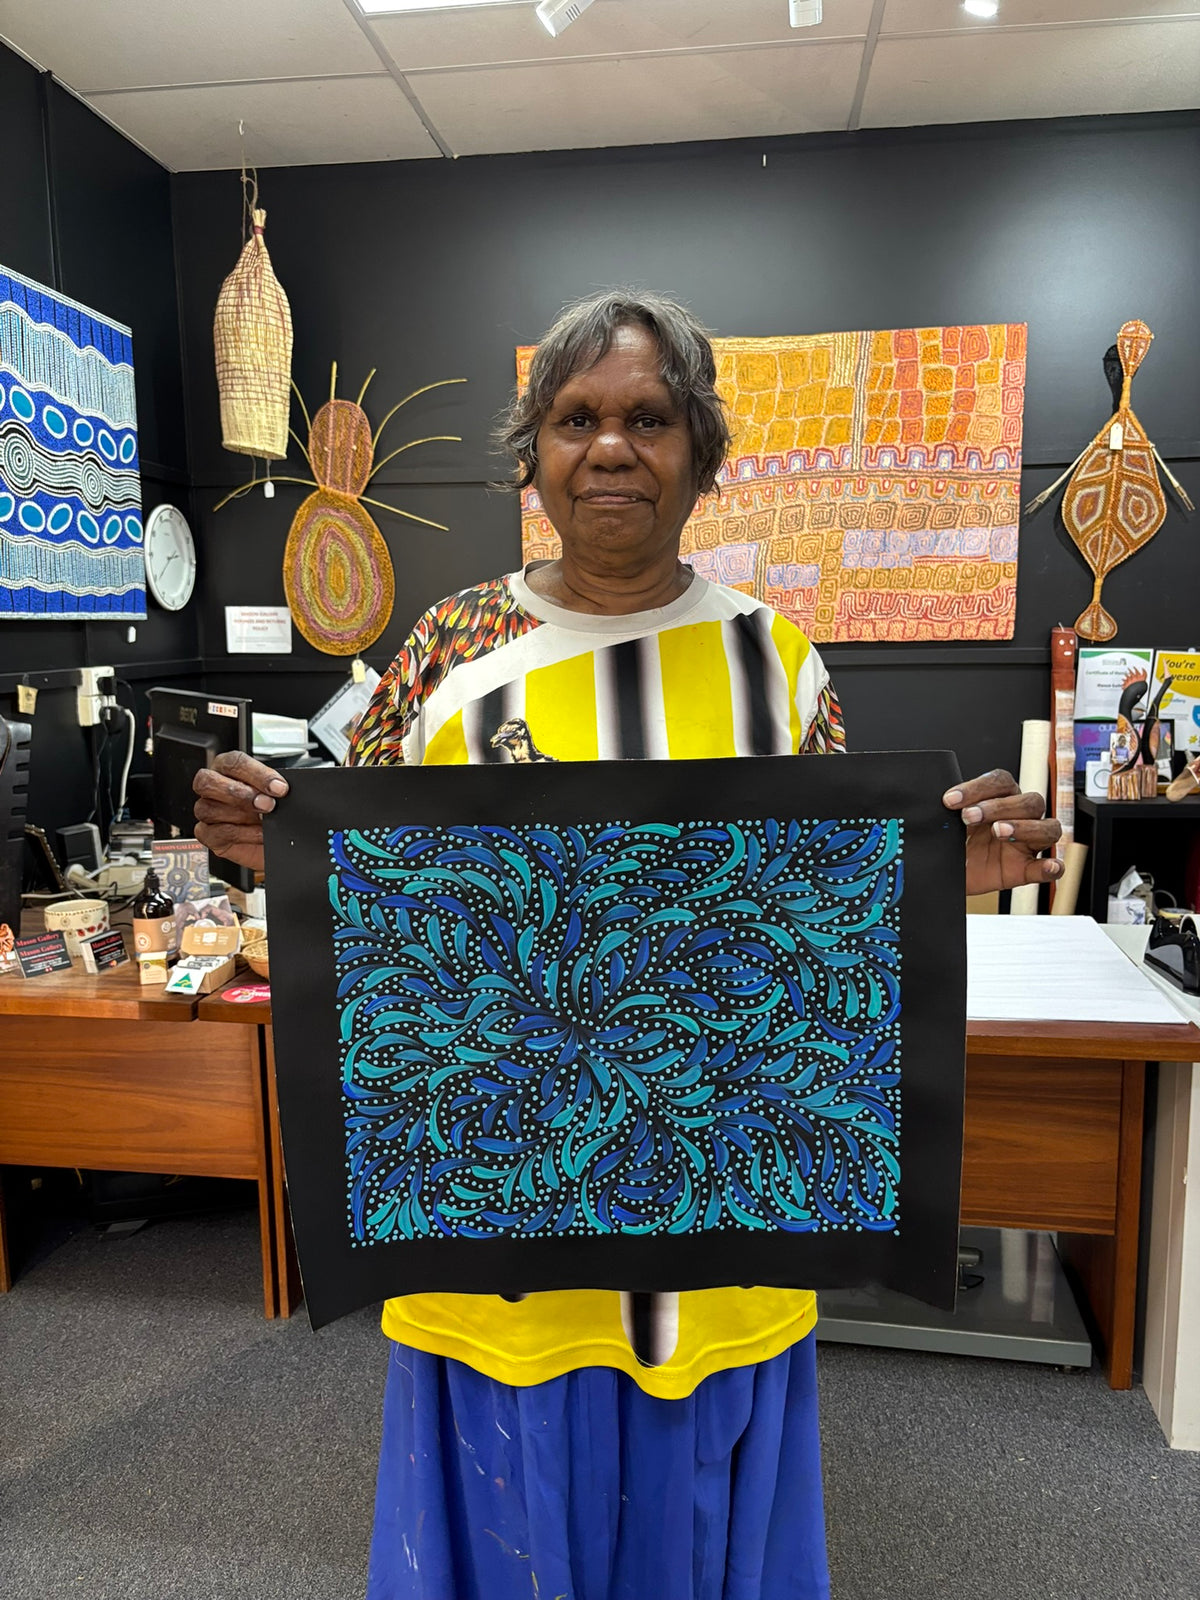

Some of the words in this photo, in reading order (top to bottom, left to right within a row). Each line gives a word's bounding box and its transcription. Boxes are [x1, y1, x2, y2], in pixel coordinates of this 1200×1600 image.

[16, 938, 37, 947] Mason
[37, 933, 60, 942] Gallery
[19, 948, 41, 957] Mason
[40, 944, 63, 953] Gallery
